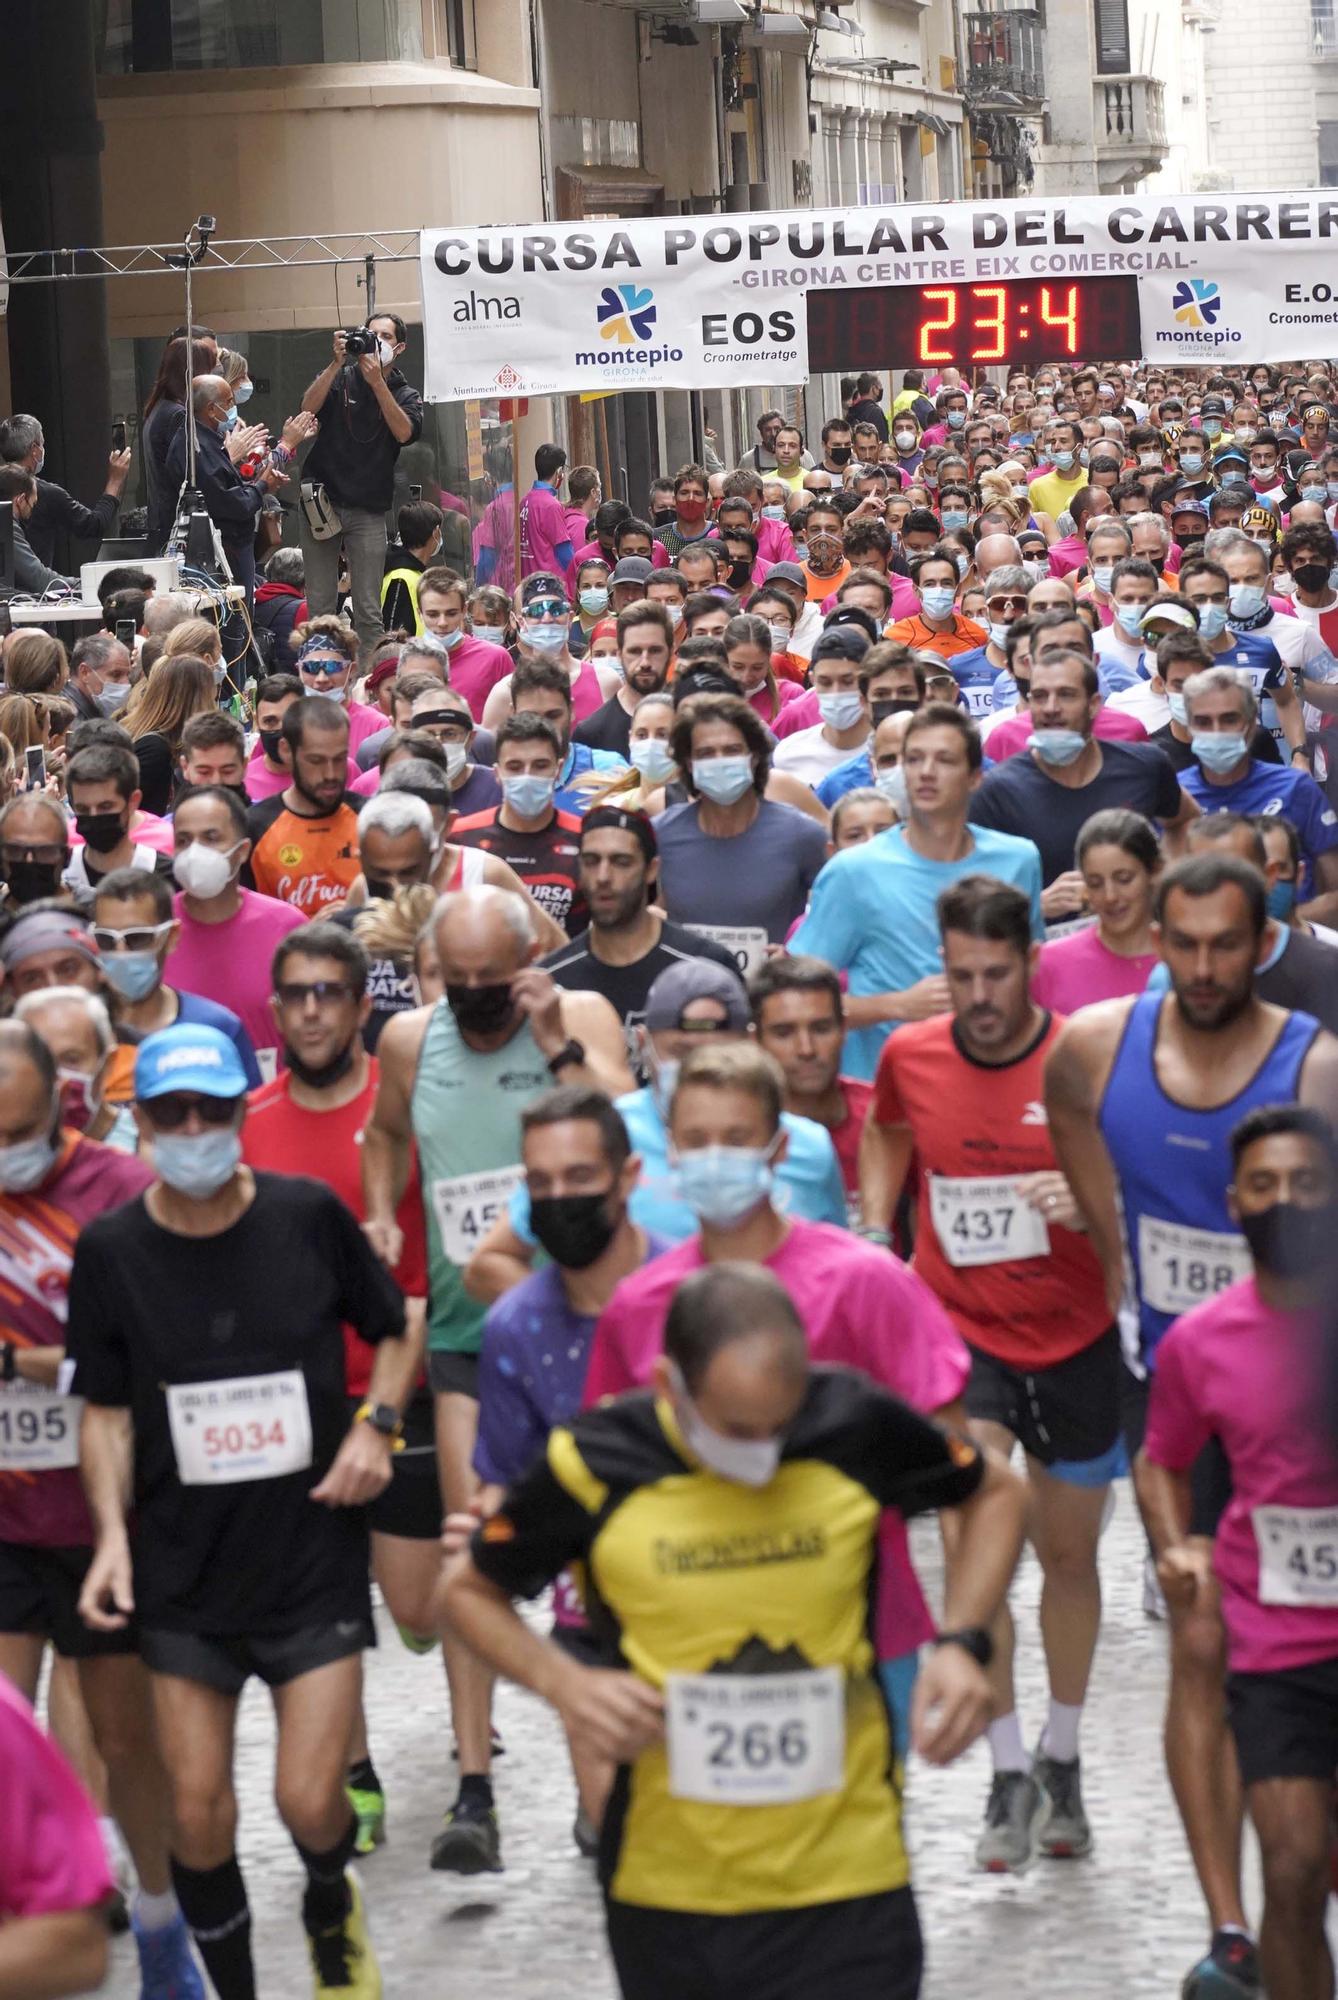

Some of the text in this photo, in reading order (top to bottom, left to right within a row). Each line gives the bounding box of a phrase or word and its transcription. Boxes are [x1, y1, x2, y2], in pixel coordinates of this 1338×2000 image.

[434, 231, 642, 276] CURSA
[664, 214, 949, 266] POPULAR
[972, 208, 1085, 249] DEL
[732, 251, 1198, 289] -GIRONA CENTRE EIX COMERCIAL-
[453, 290, 521, 323] alma
[702, 310, 796, 346] EOS
[1156, 328, 1242, 346] montepio
[575, 343, 683, 368] montepio
[603, 367, 648, 377] GIRONA
[703, 349, 798, 363] Cronometratge
[452, 385, 497, 396] Ajuntament
[518, 382, 527, 391] de
[952, 1207, 1014, 1241] 437
[0, 1406, 66, 1444] 195
[203, 1418, 287, 1456] 5034
[705, 1719, 809, 1769] 266
